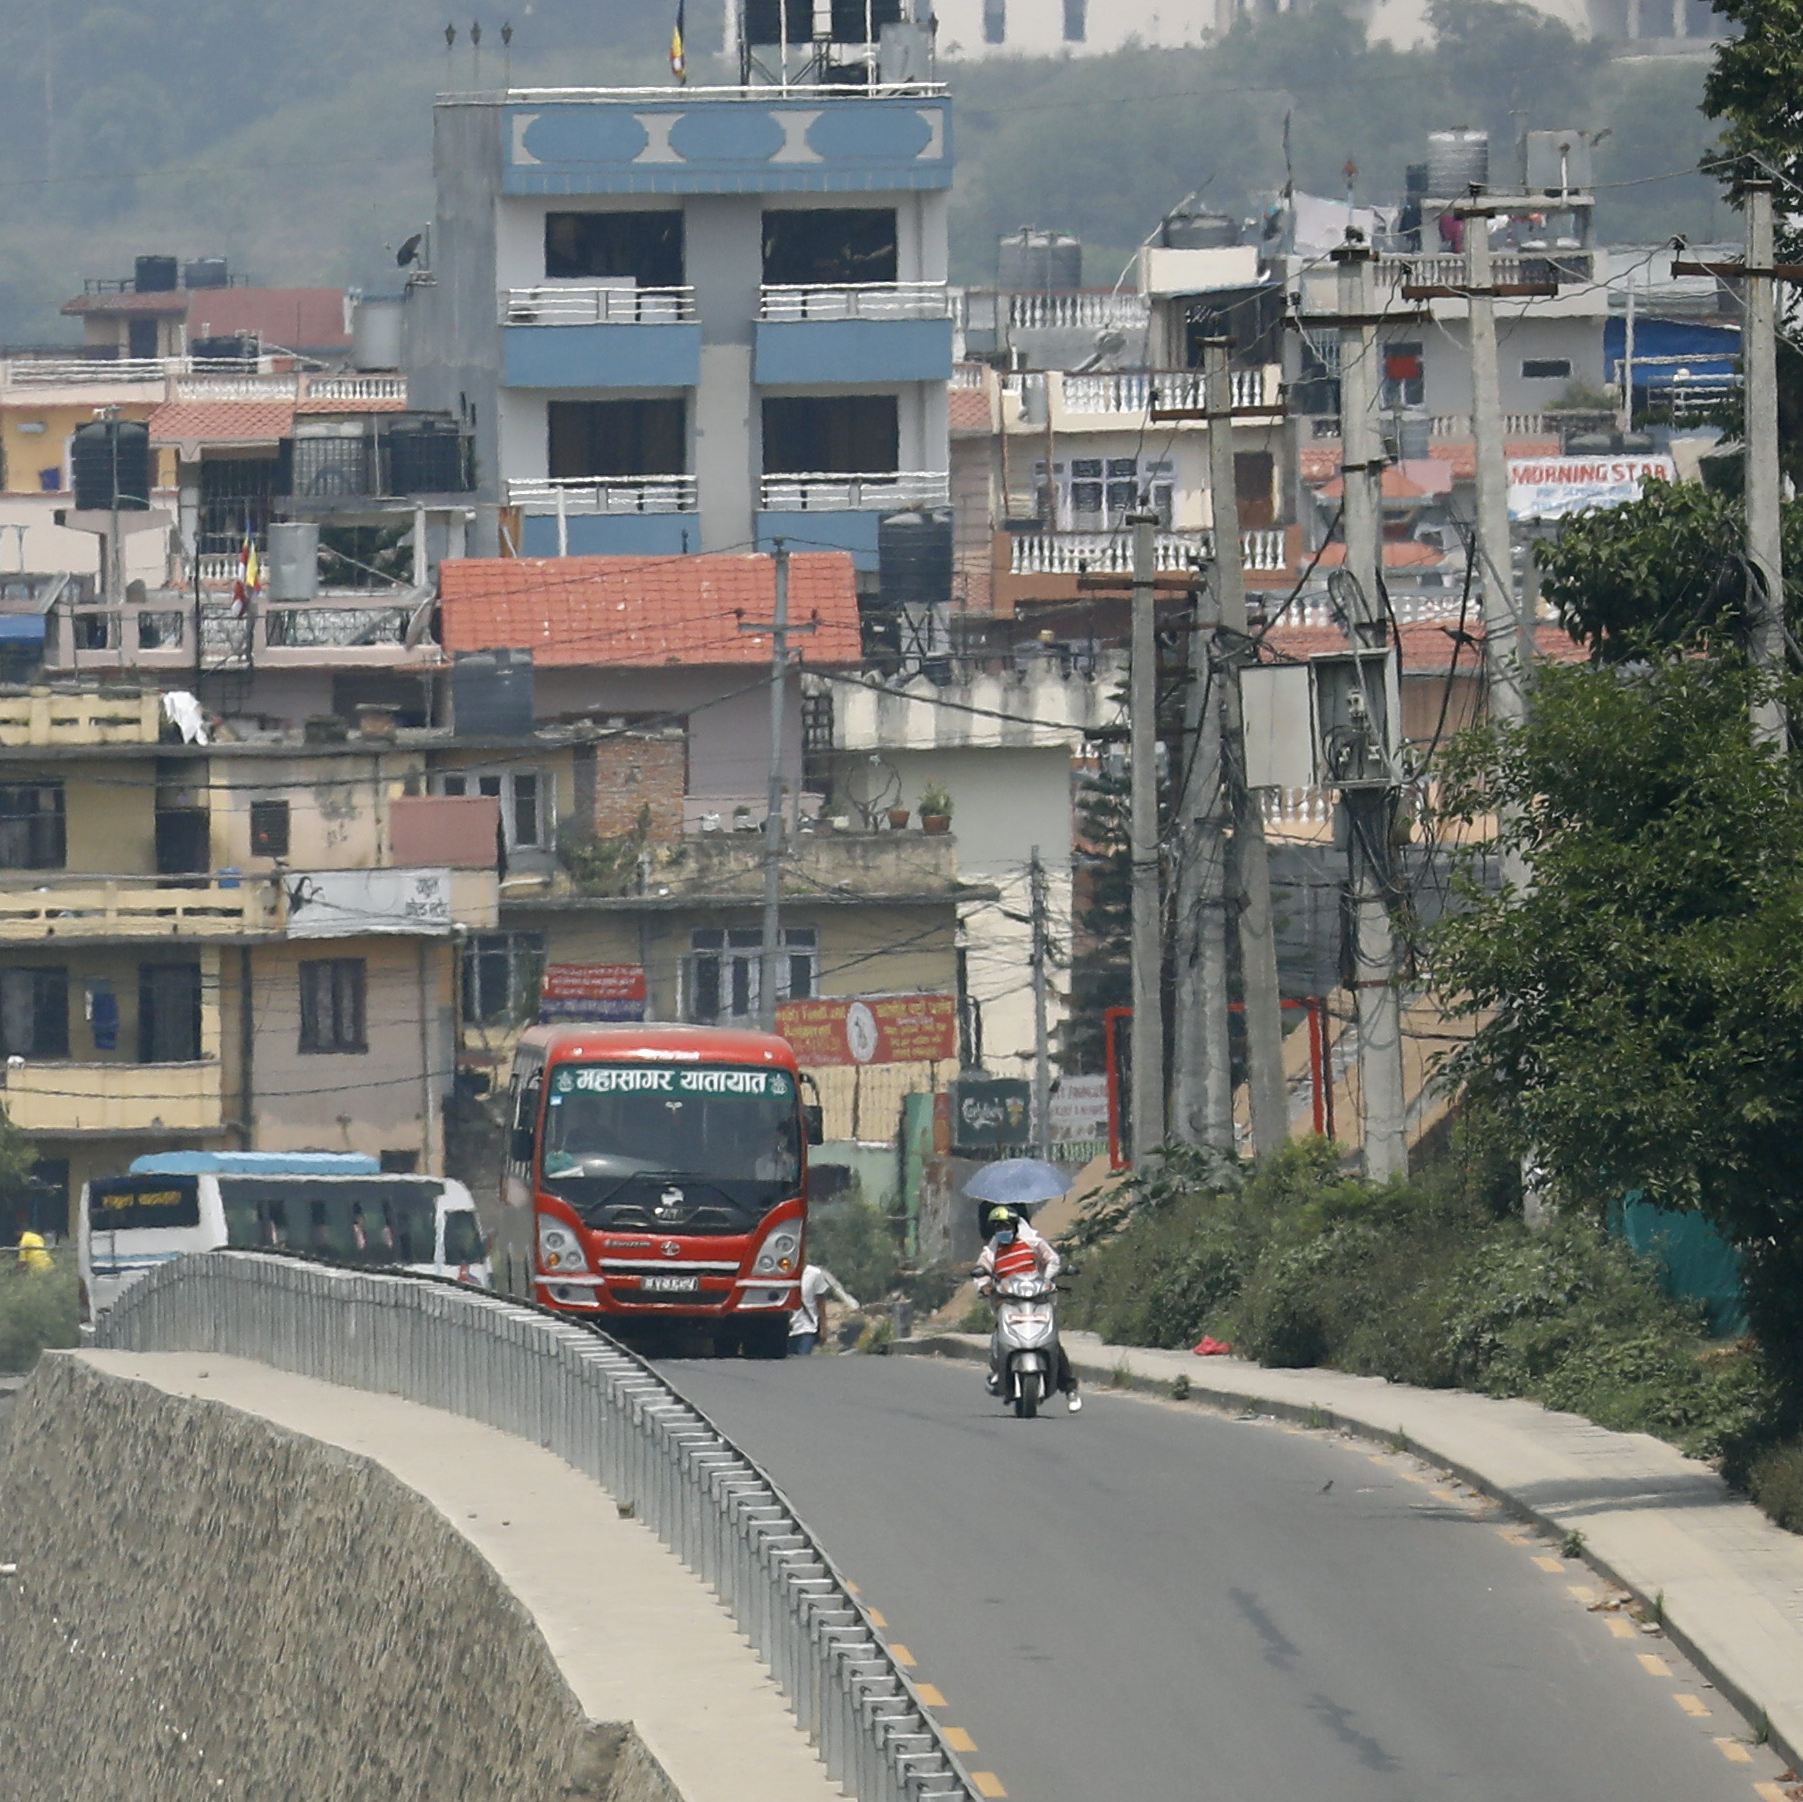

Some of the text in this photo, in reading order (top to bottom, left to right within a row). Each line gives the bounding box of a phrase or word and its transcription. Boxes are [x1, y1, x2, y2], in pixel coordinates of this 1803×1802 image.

[1512, 463, 1608, 485] MORNING
[576, 1069, 768, 1094] महासागर यातायात
